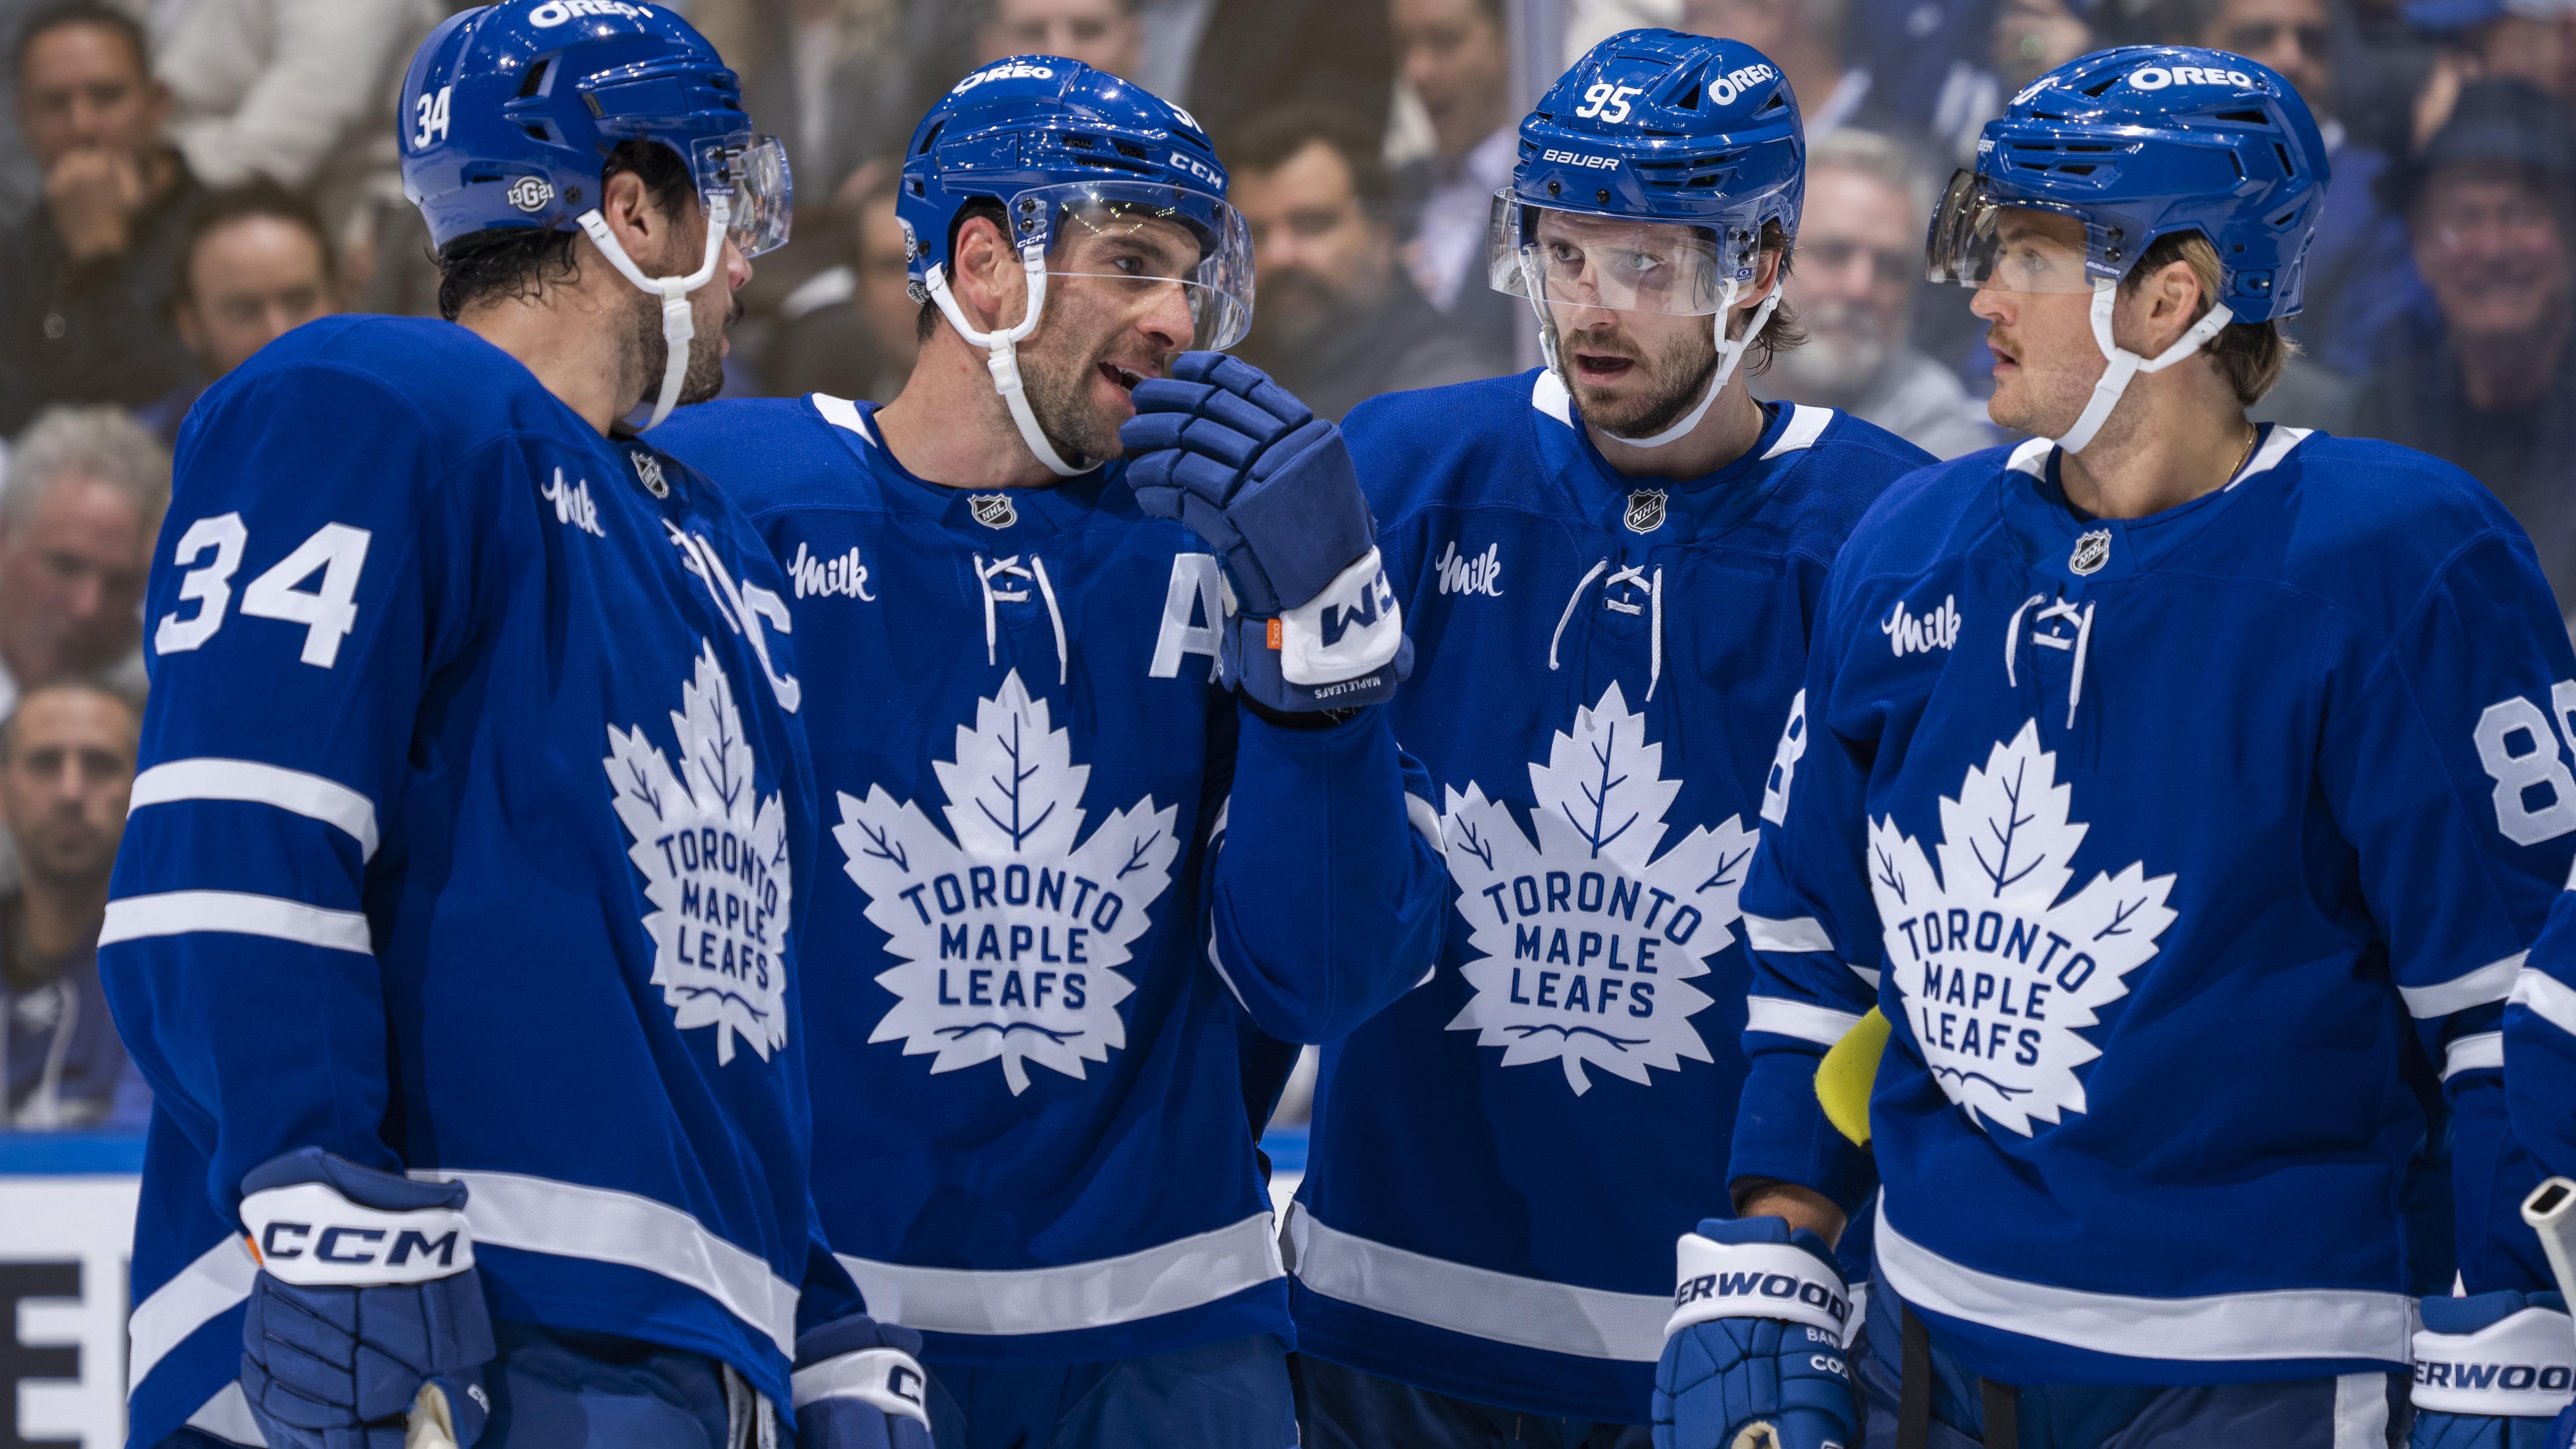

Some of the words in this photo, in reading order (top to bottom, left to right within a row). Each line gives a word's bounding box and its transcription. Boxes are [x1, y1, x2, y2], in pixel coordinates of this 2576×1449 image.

[529, 0, 639, 28] OREO
[952, 65, 1053, 95] OREO
[1575, 83, 1643, 124] 95
[1708, 63, 1774, 107] OREO
[2128, 66, 2252, 92] OREO
[414, 86, 452, 149] 34
[1169, 151, 1223, 190] CCM
[1016, 231, 1048, 248] CCM
[541, 466, 606, 538] Milk
[981, 503, 1005, 521] NHL
[1633, 500, 1659, 524] NHL
[155, 510, 372, 670] 34
[787, 541, 876, 602] Milk
[1436, 540, 1504, 596] Milk
[1148, 553, 1224, 684] A
[1881, 594, 1961, 658] Milk
[1314, 683, 1347, 699] LEAFS
[1347, 676, 1381, 692] MAPLE
[2473, 678, 2576, 846] 8
[655, 826, 778, 919] TORONTO
[899, 864, 1123, 934] TORONTO
[680, 878, 768, 946] MAPLE
[1482, 871, 1702, 945] TORONTO
[677, 924, 769, 990] LEAFS
[940, 923, 1088, 963] MAPLE
[1514, 923, 1661, 974] MAPLE
[1898, 908, 2096, 993] TORONTO
[938, 968, 1087, 1009] LEAFS
[1510, 967, 1655, 1018] LEAFS
[1923, 960, 2051, 1021] MAPLE
[1923, 1007, 2042, 1066] LEAFS
[263, 1222, 459, 1267] CCM
